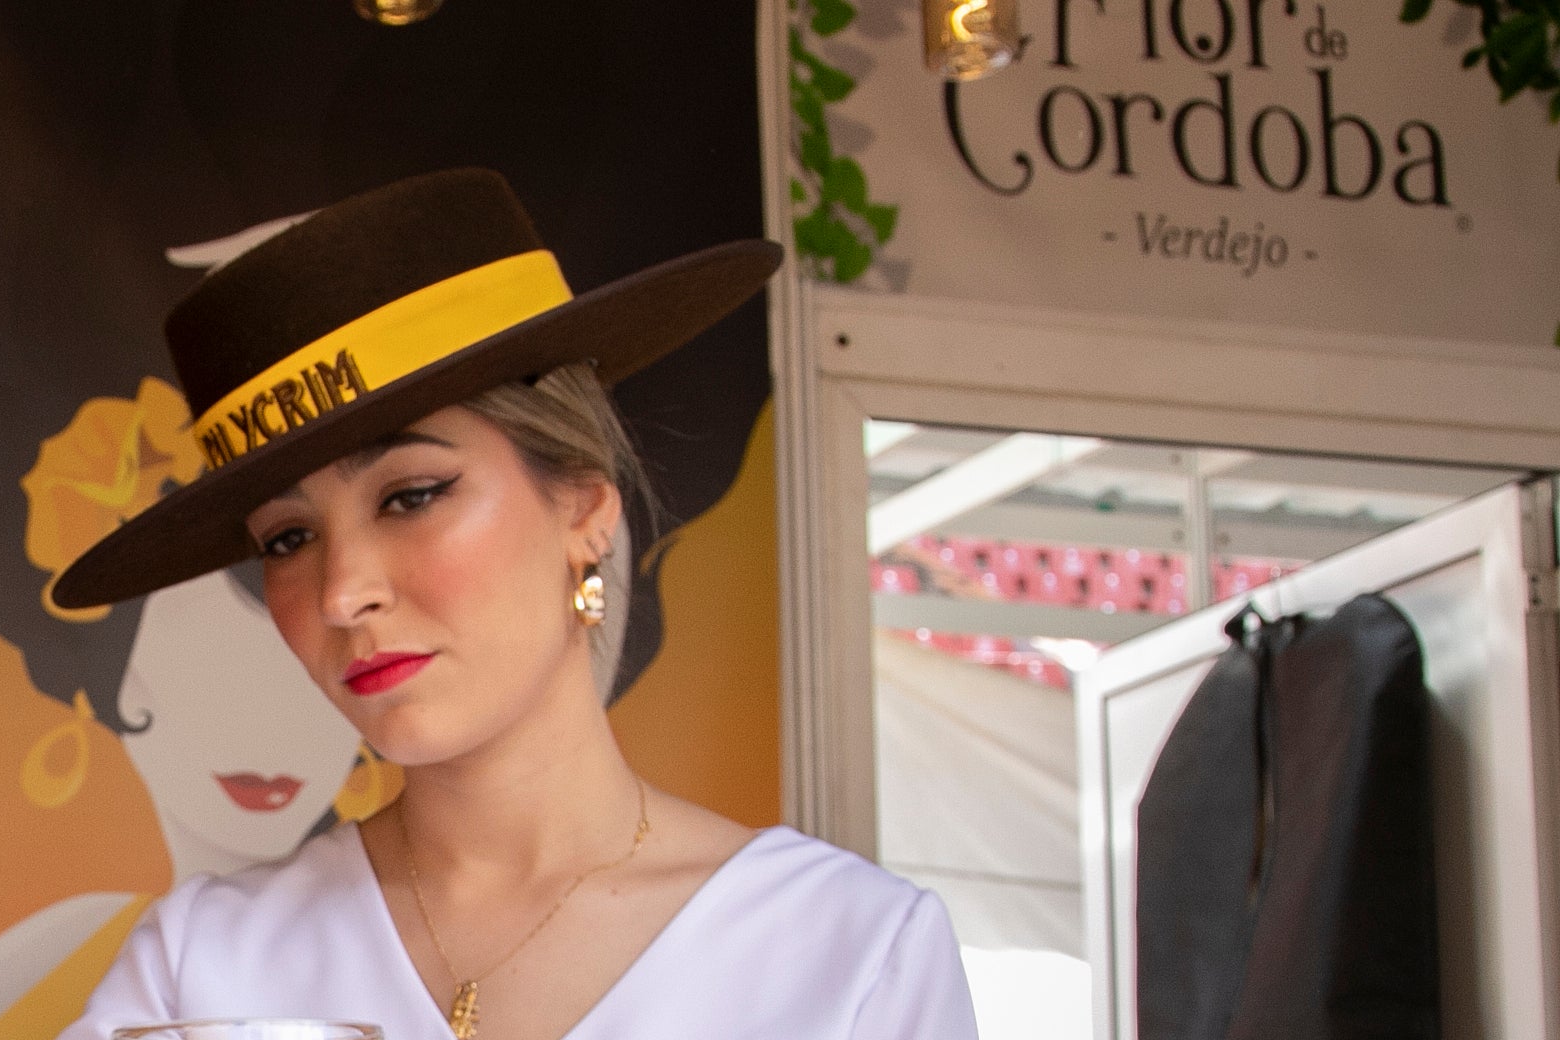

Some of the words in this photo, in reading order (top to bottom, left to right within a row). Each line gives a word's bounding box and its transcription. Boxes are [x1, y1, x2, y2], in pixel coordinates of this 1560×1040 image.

[1303, 5, 1349, 61] de
[943, 66, 1452, 207] Cordoba
[1135, 211, 1290, 278] Verdejo
